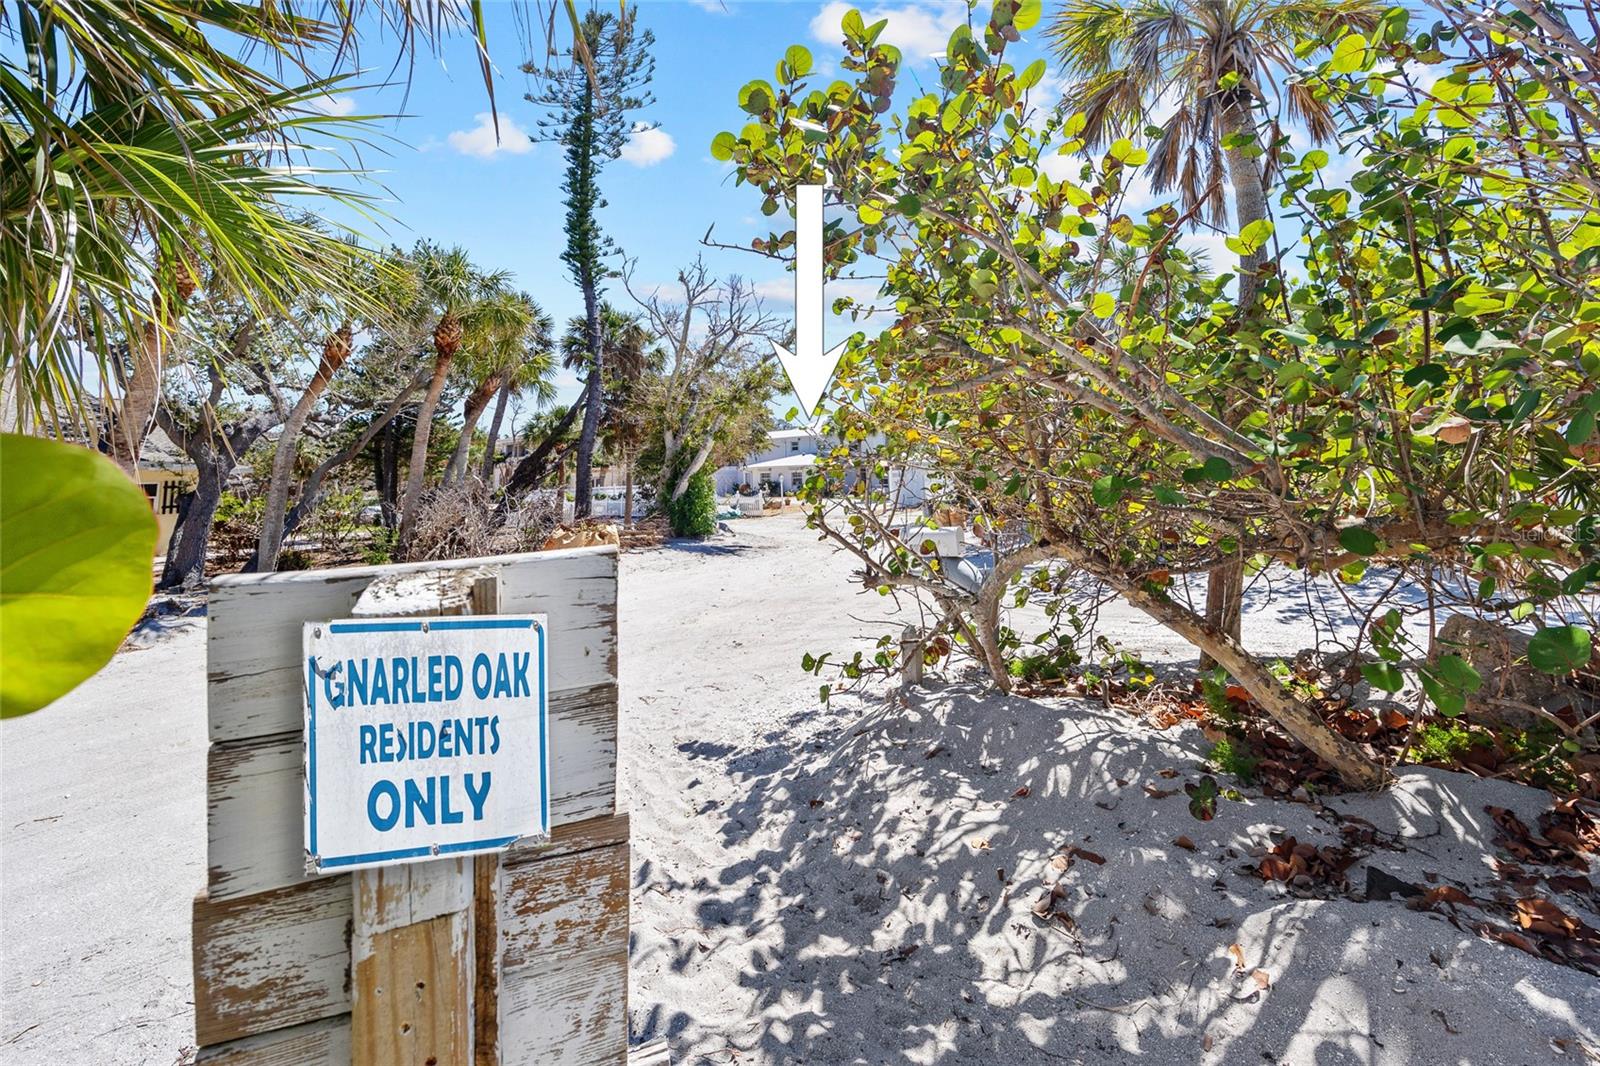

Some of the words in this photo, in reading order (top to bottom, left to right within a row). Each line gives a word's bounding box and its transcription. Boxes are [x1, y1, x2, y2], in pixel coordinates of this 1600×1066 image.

[324, 655, 463, 710] GNARLED
[472, 652, 531, 700] OAK
[367, 771, 492, 832] ONLY
